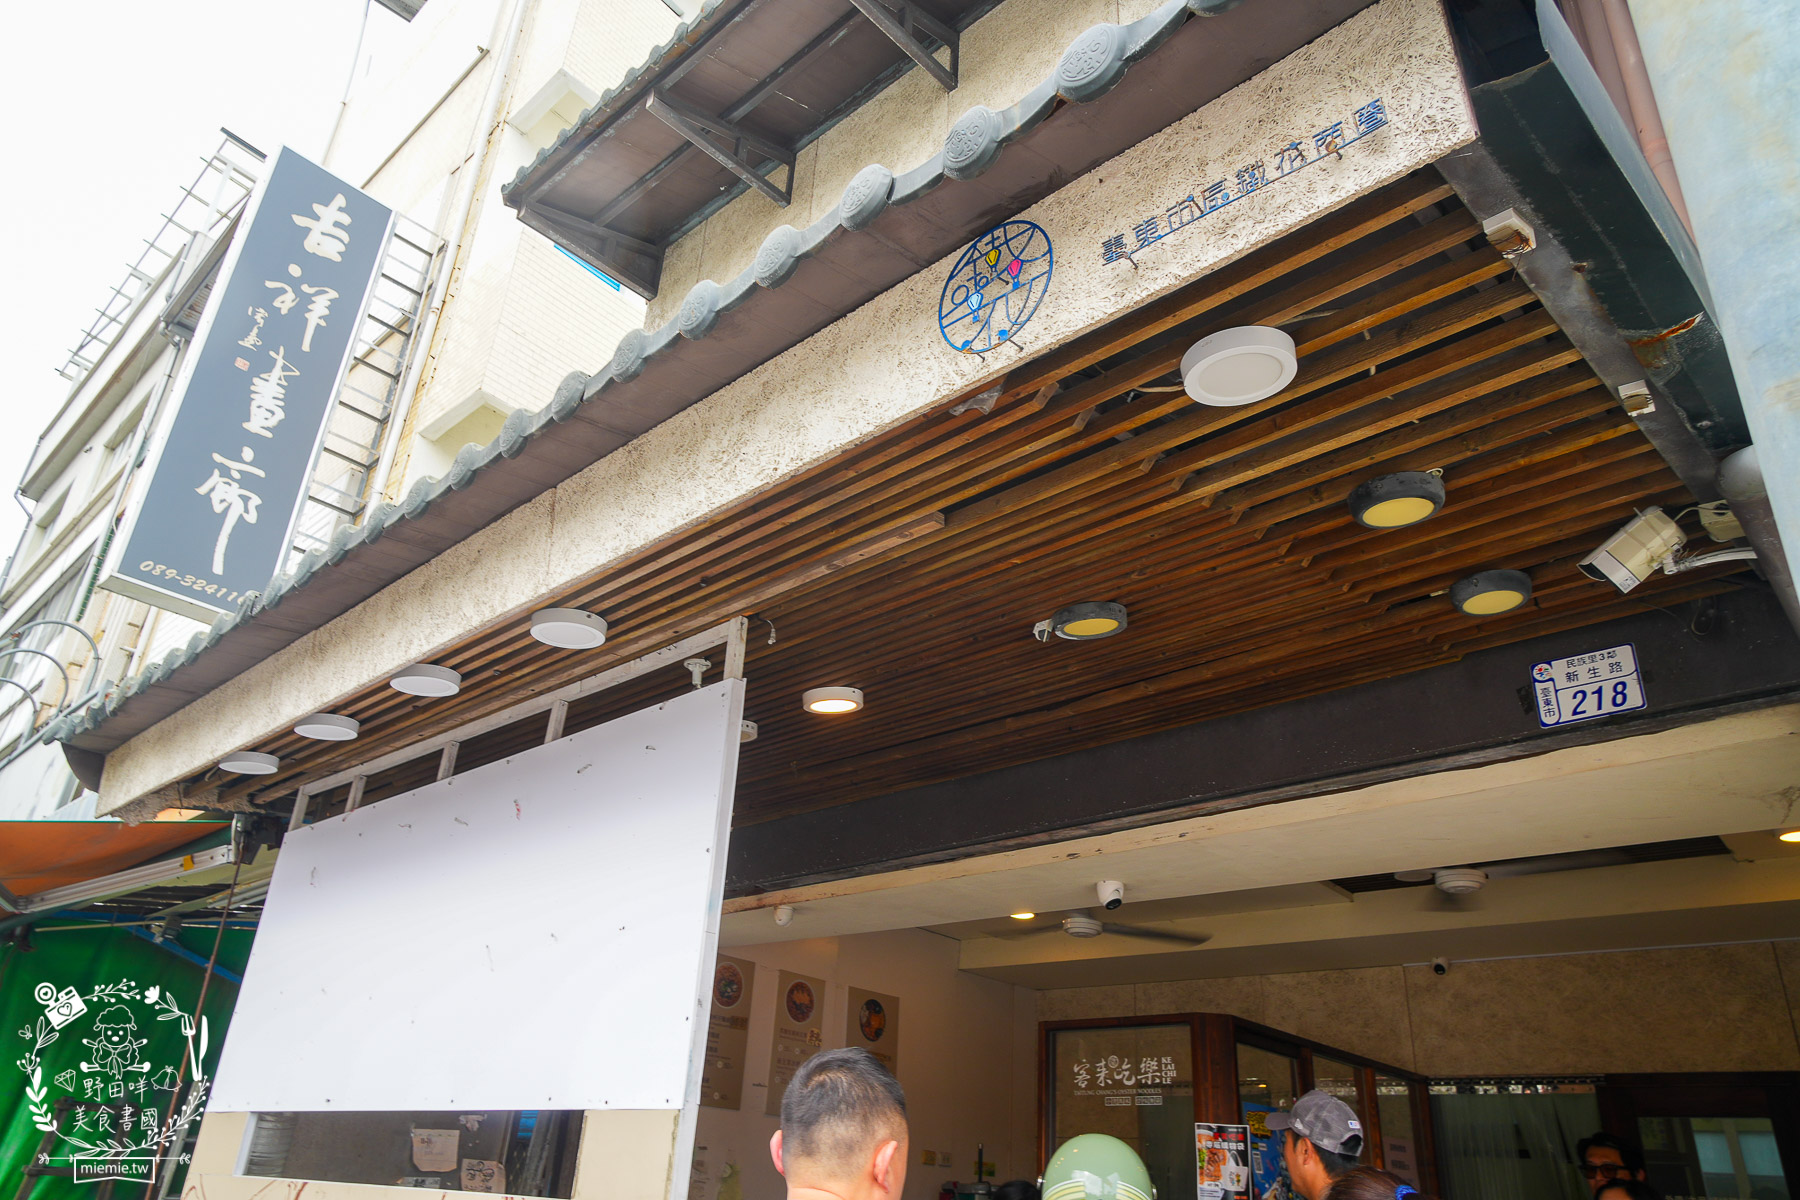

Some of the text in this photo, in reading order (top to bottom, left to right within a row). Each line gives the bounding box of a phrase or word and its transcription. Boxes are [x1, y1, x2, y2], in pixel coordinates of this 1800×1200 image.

[1565, 661, 1623, 683] 新生路
[1571, 681, 1628, 717] 218
